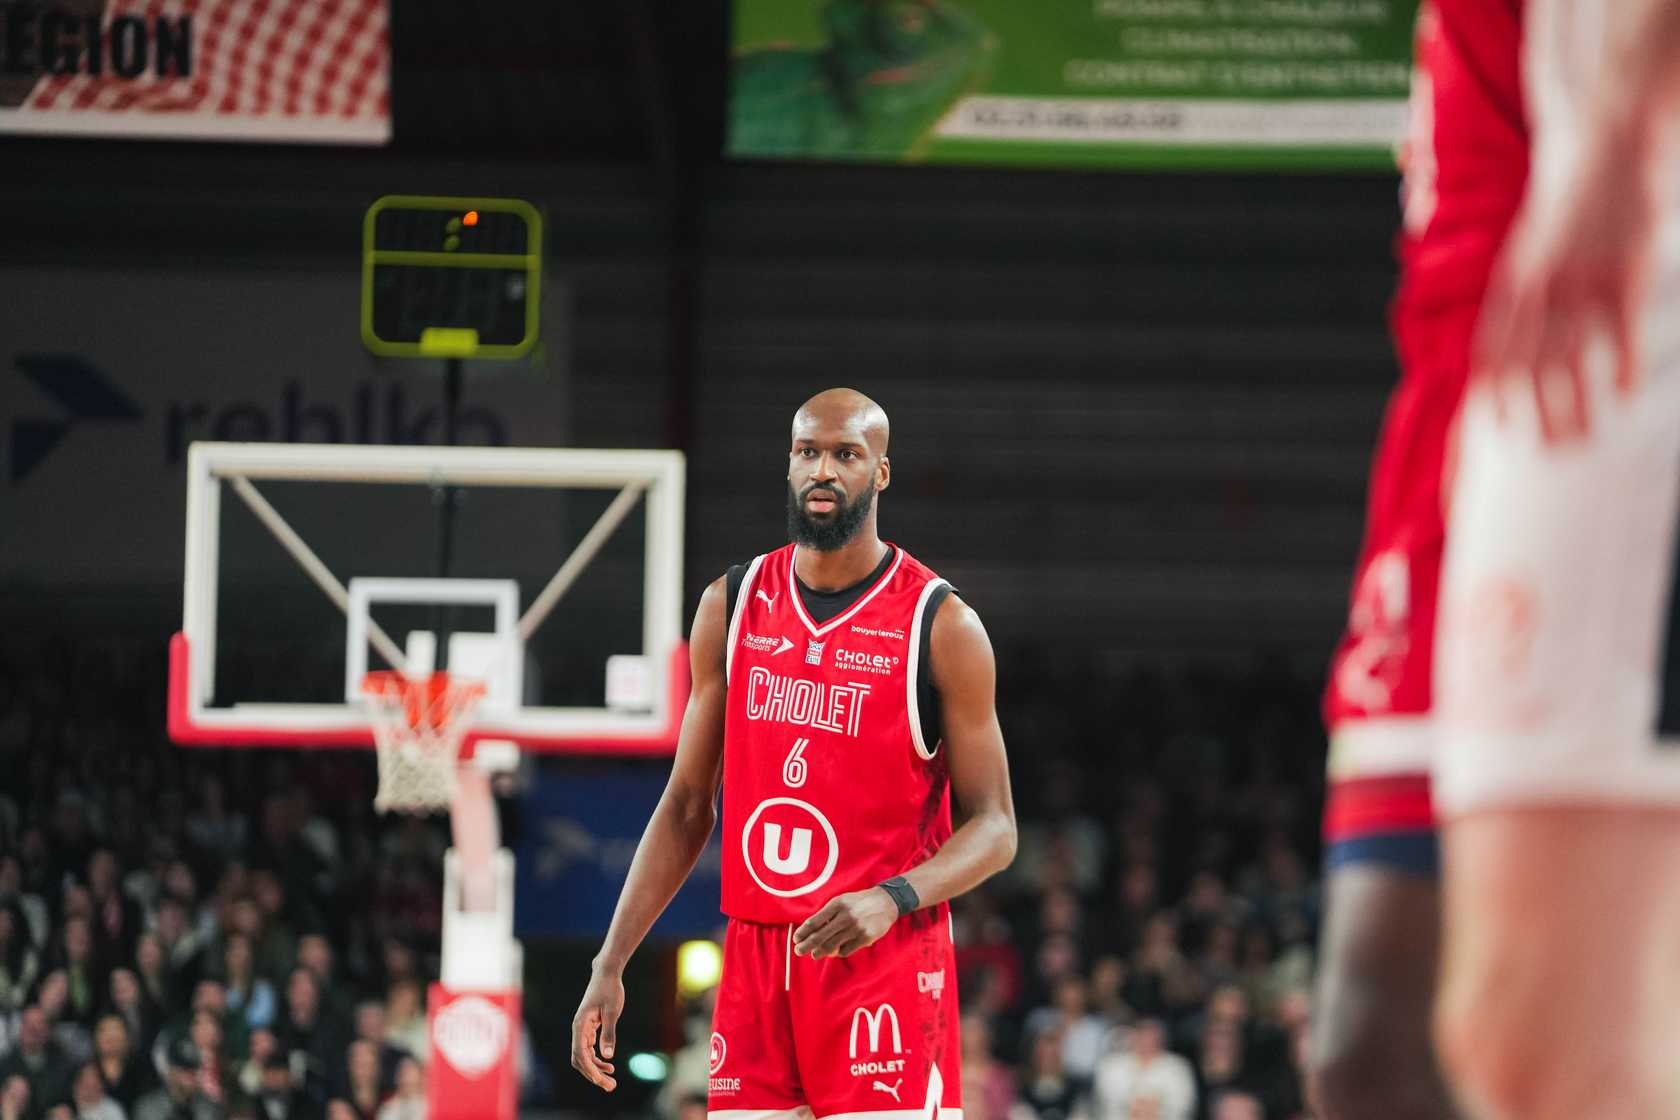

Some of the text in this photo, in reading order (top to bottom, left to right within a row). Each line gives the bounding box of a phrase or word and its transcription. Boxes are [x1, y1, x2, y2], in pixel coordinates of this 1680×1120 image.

[747, 666, 871, 737] CHOLET
[782, 737, 809, 788] 6
[850, 1060, 905, 1076] CHOLET
